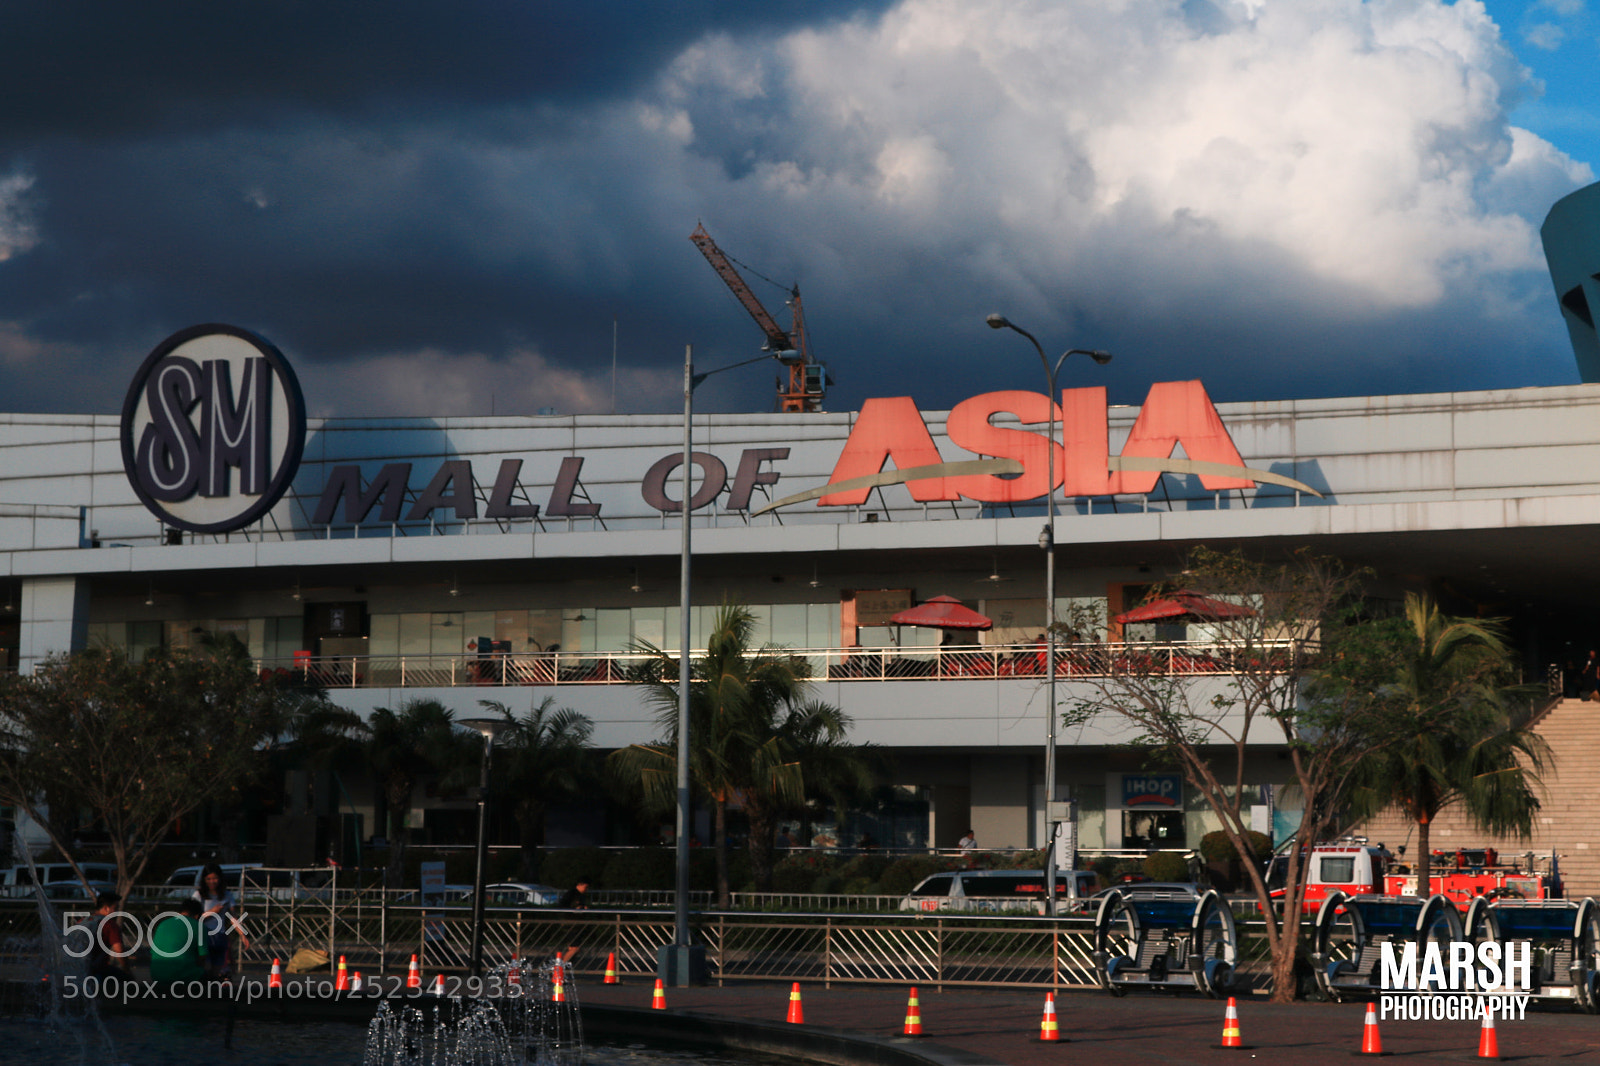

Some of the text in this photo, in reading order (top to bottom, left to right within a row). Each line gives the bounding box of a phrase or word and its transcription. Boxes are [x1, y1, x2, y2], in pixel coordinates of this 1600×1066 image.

[136, 356, 1257, 525] SM MALL OF ASIA
